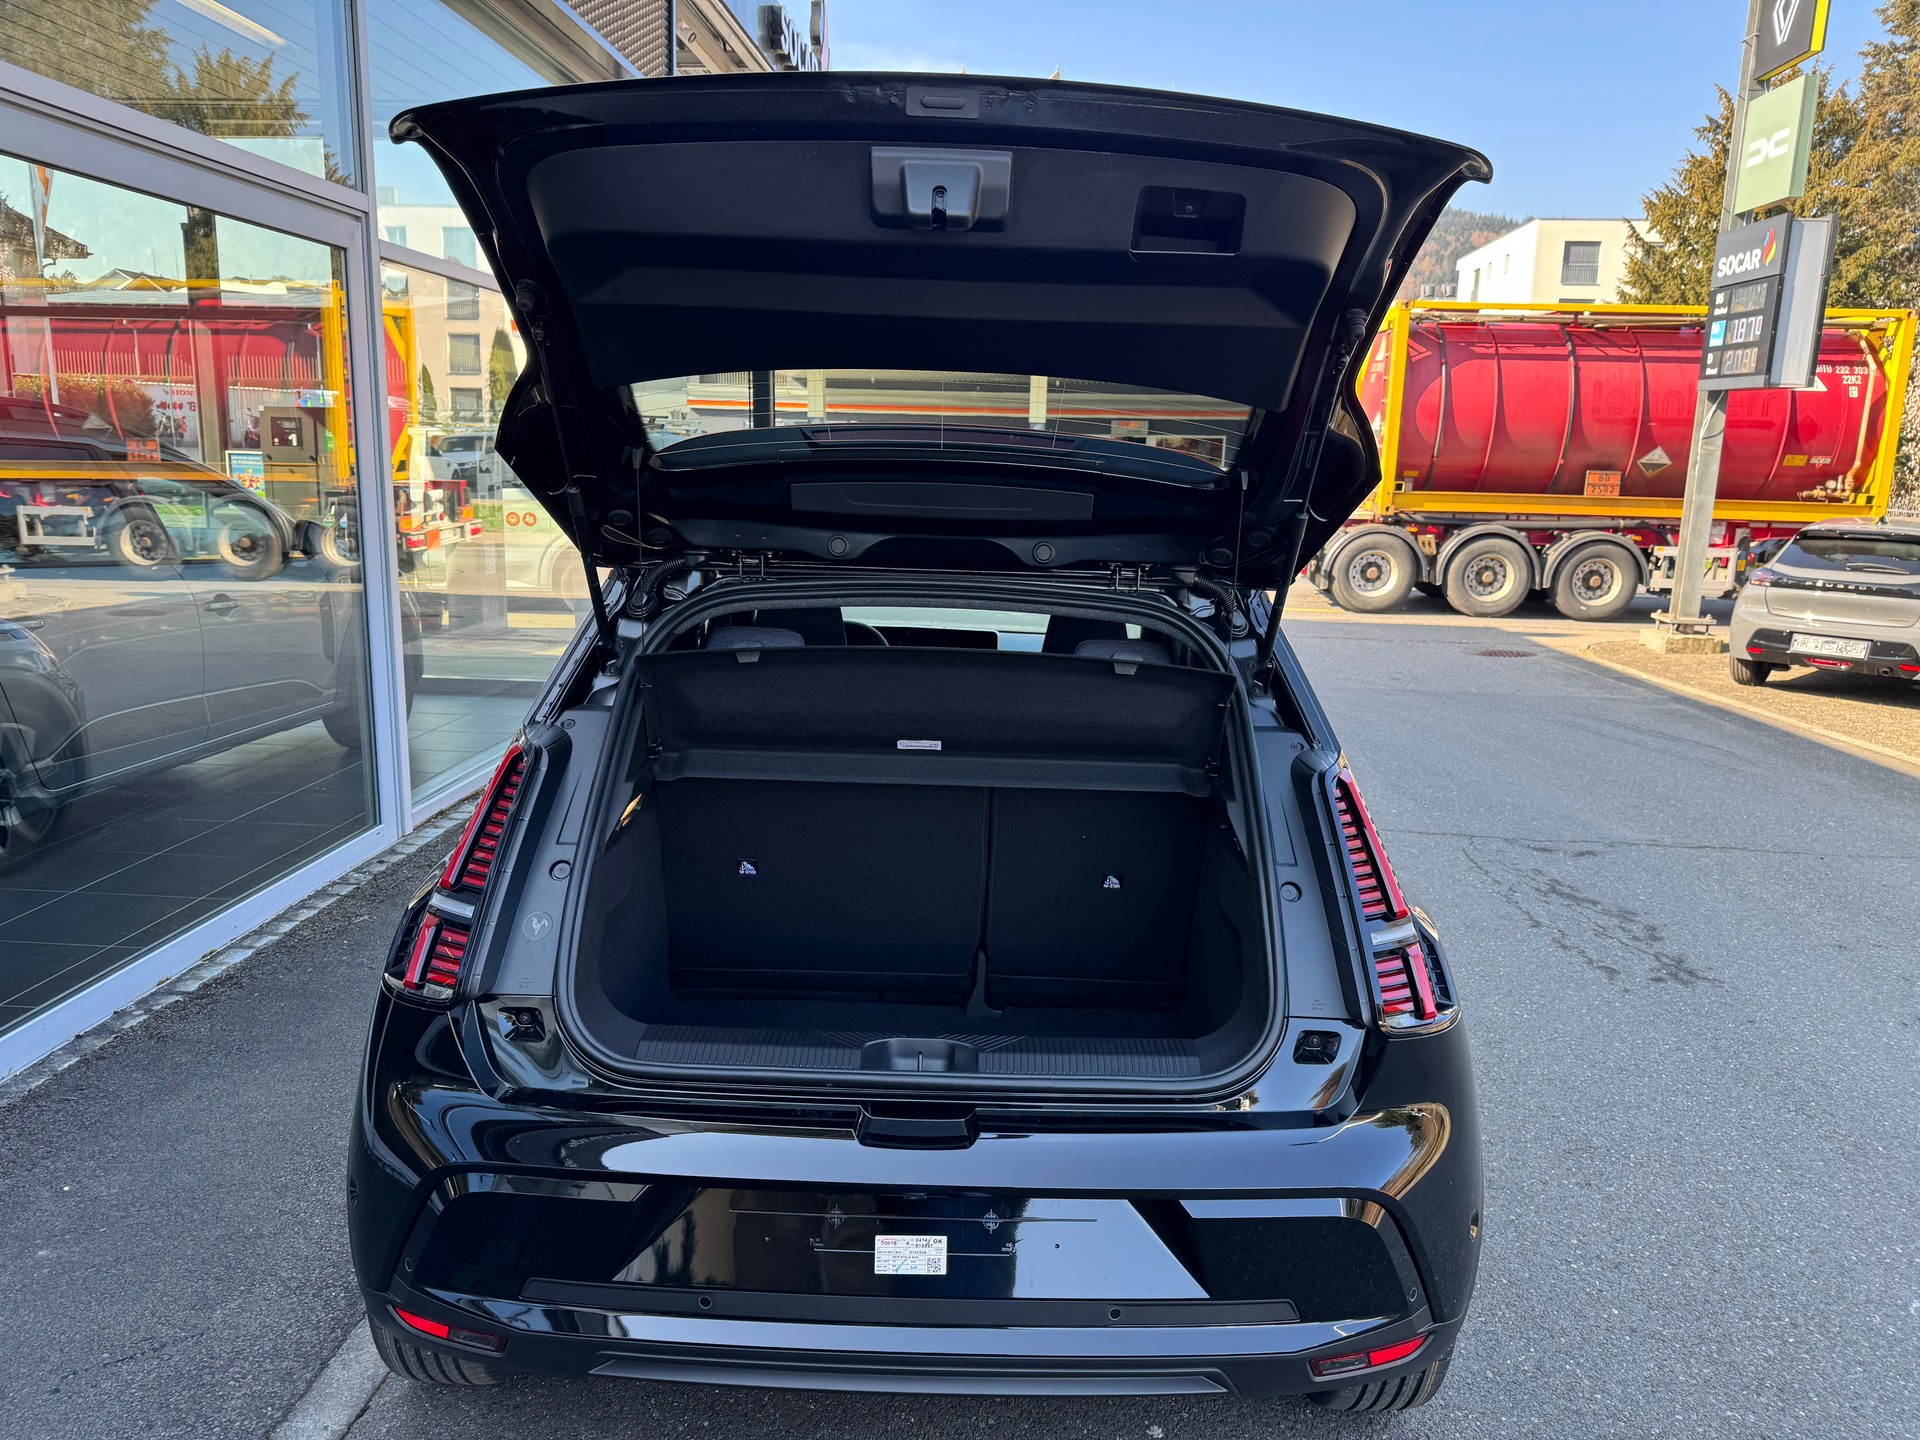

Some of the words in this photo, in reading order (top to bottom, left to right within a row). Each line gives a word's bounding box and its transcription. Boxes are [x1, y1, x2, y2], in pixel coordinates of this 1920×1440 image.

[1717, 248, 1762, 278] SOCAR
[1835, 365, 1851, 374] 222
[1853, 366, 1868, 375] 303
[1842, 375, 1863, 384] 22K2
[287, 433, 298, 447] 1
